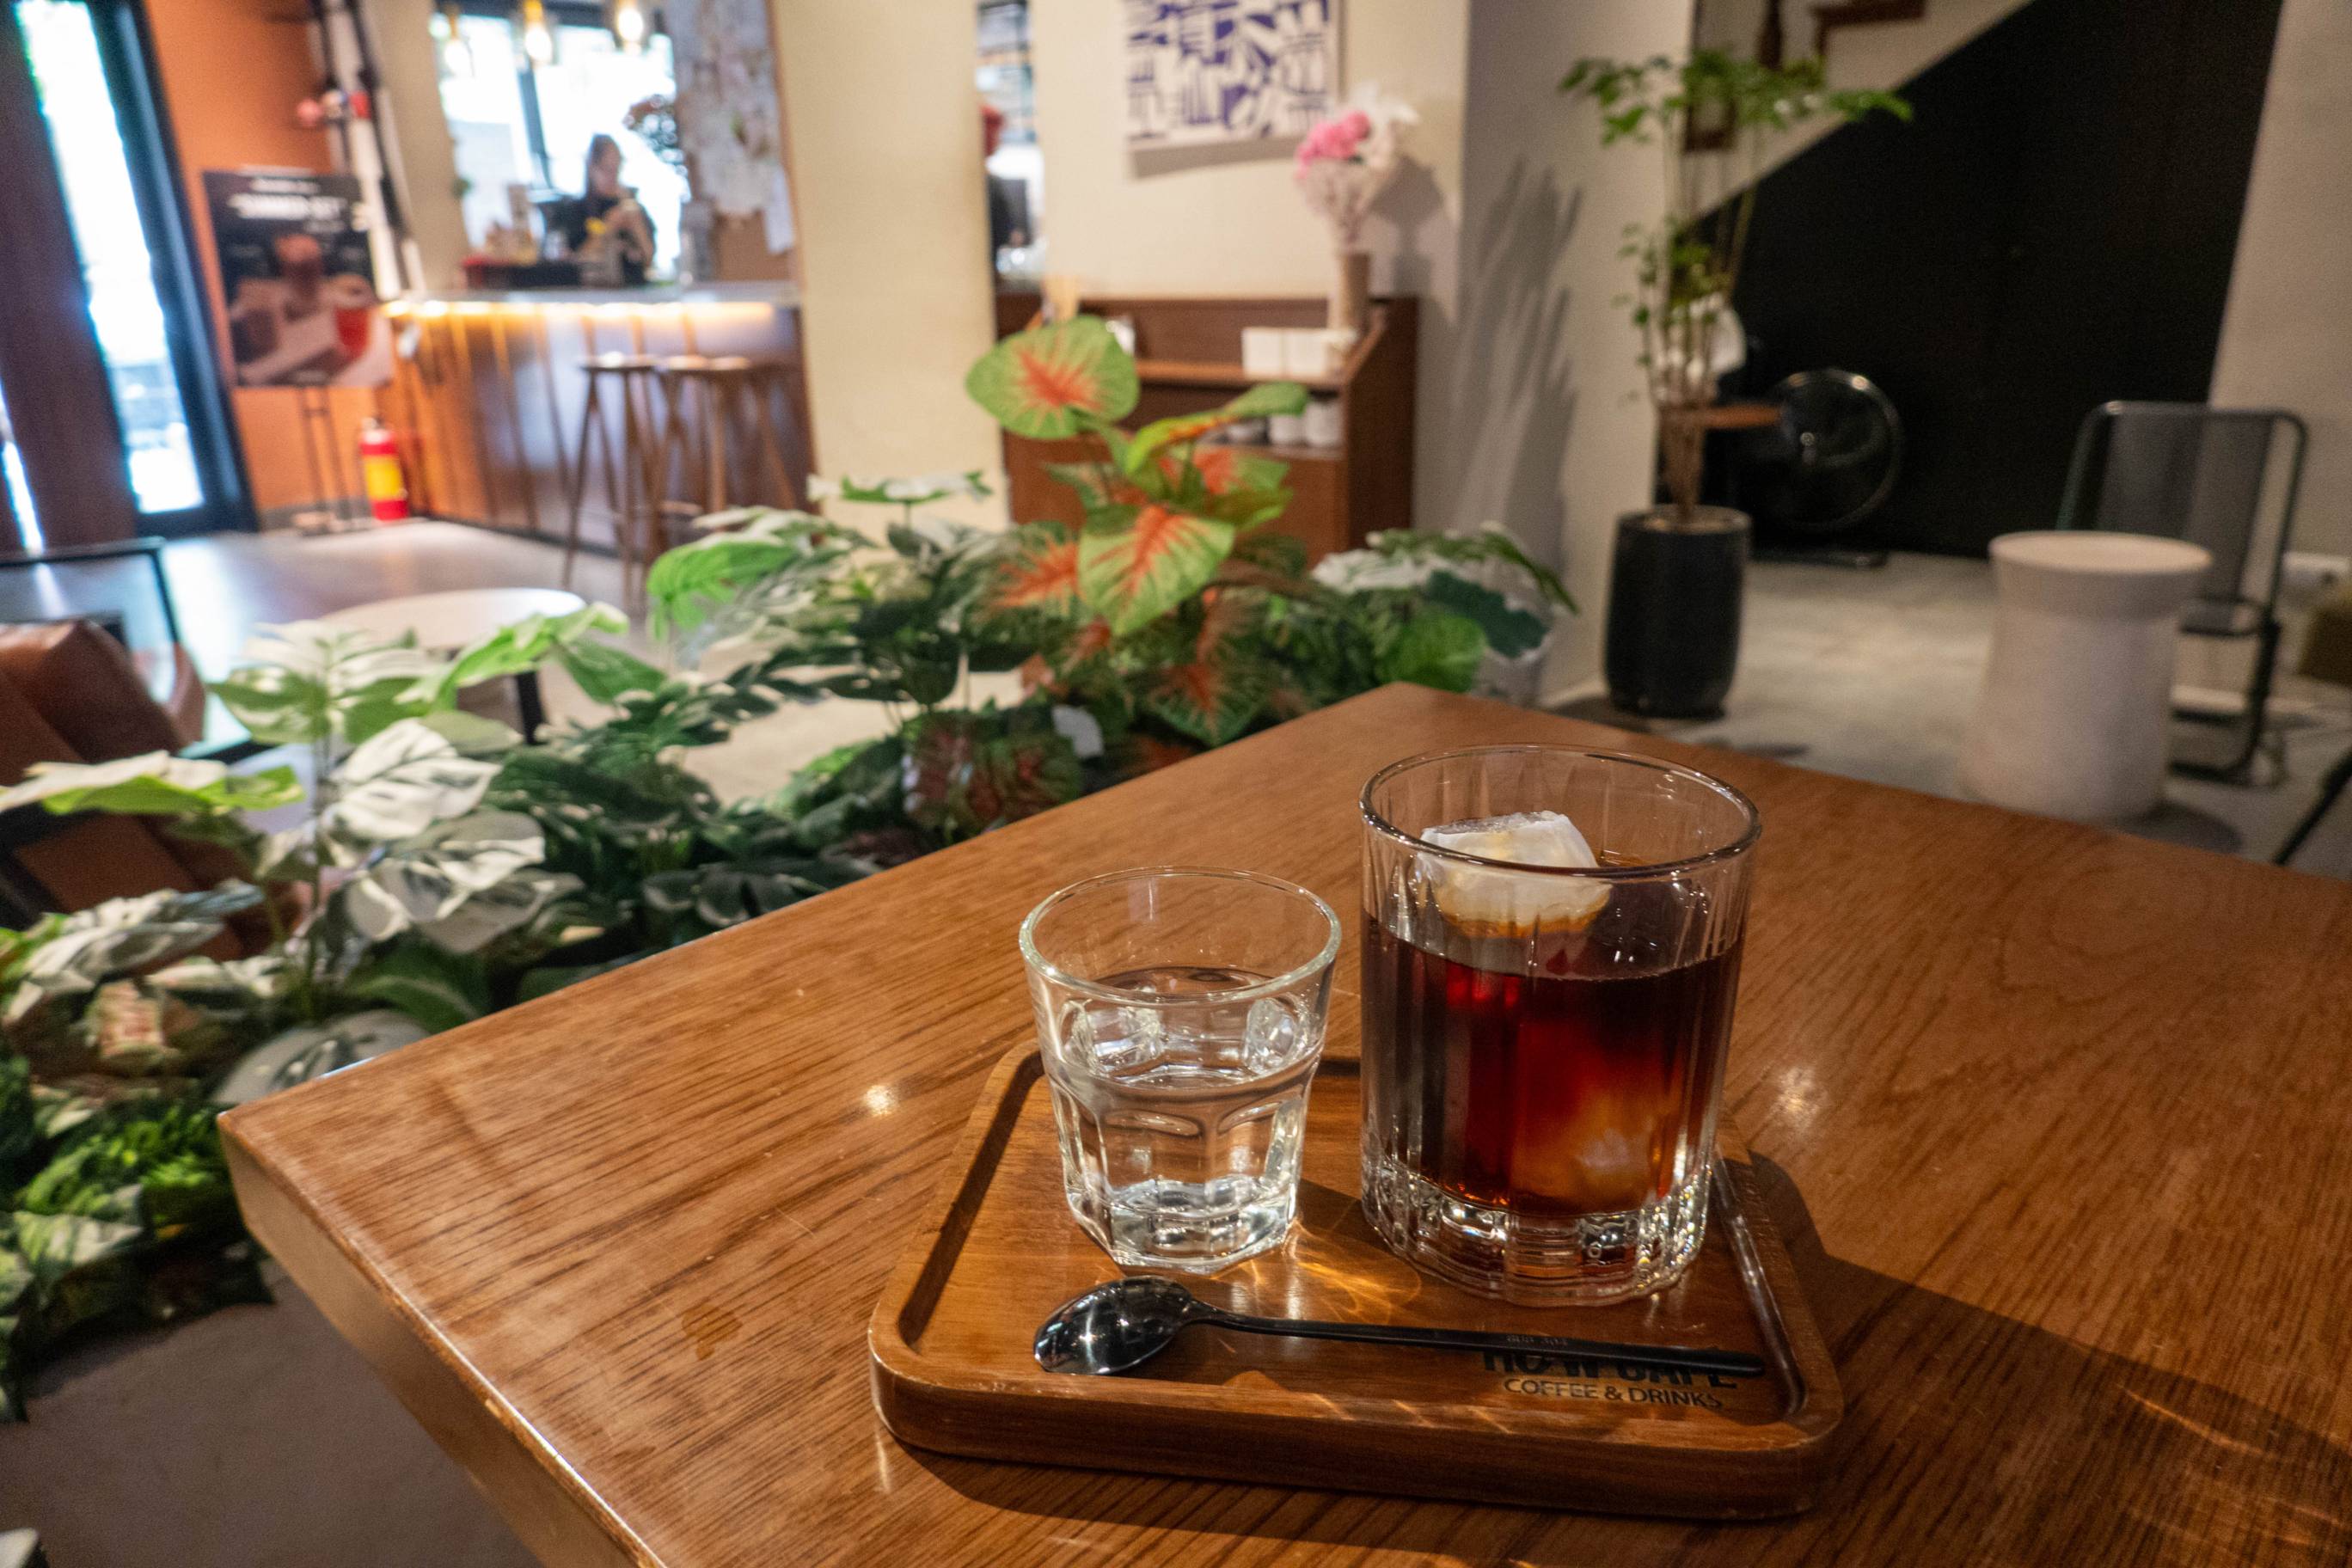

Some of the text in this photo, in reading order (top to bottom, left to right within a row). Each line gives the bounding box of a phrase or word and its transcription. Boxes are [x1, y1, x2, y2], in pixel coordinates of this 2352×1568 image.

[1504, 1378, 1723, 1407] COFFEE & DRINKS
